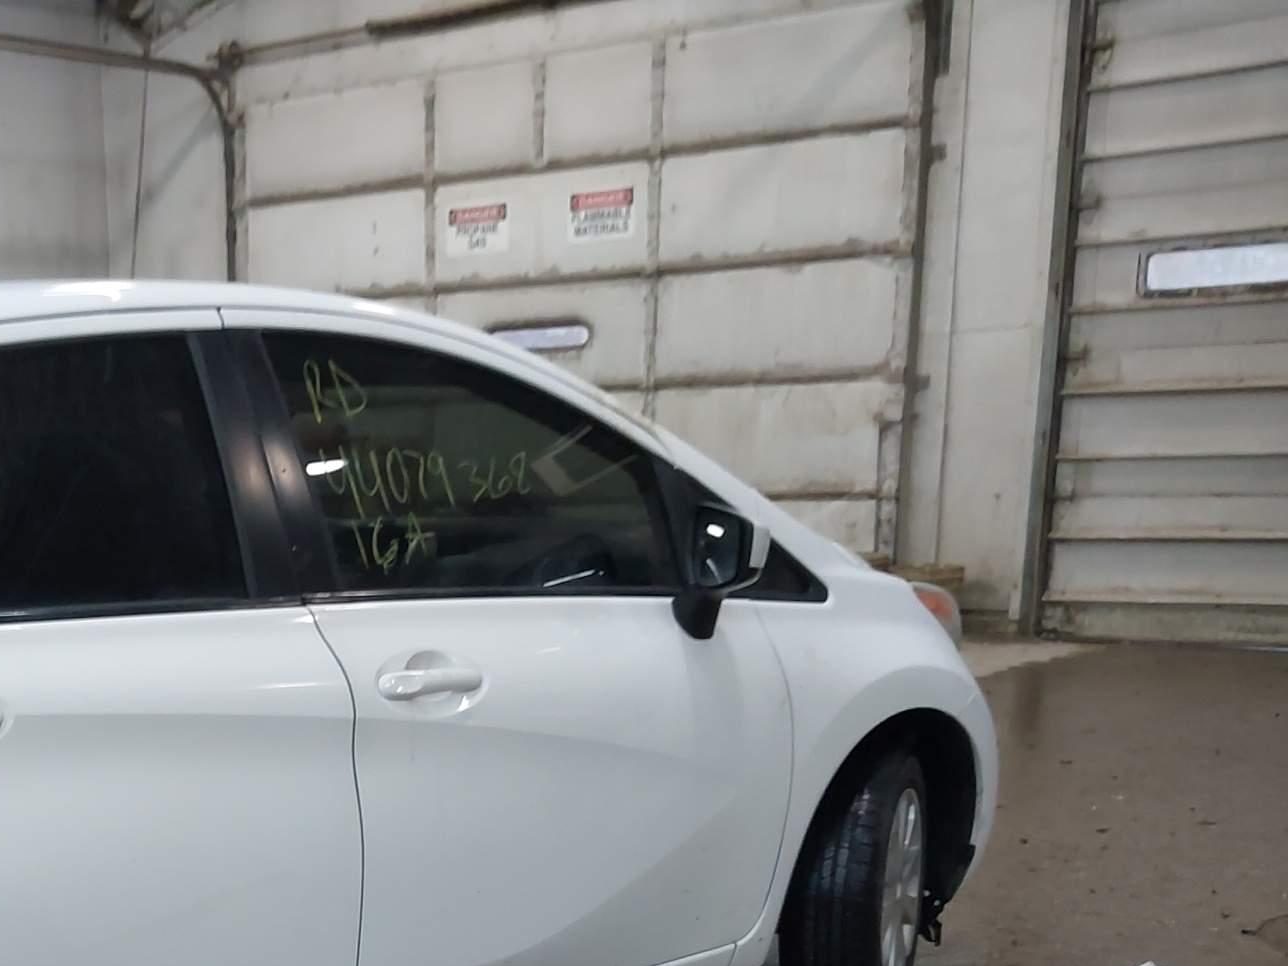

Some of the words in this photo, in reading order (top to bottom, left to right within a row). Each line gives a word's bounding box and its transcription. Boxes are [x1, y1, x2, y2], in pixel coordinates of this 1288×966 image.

[456, 223, 498, 237] PROPANE
[574, 221, 628, 237] MATERIALS
[468, 235, 487, 250] GAS
[303, 357, 368, 424] RD
